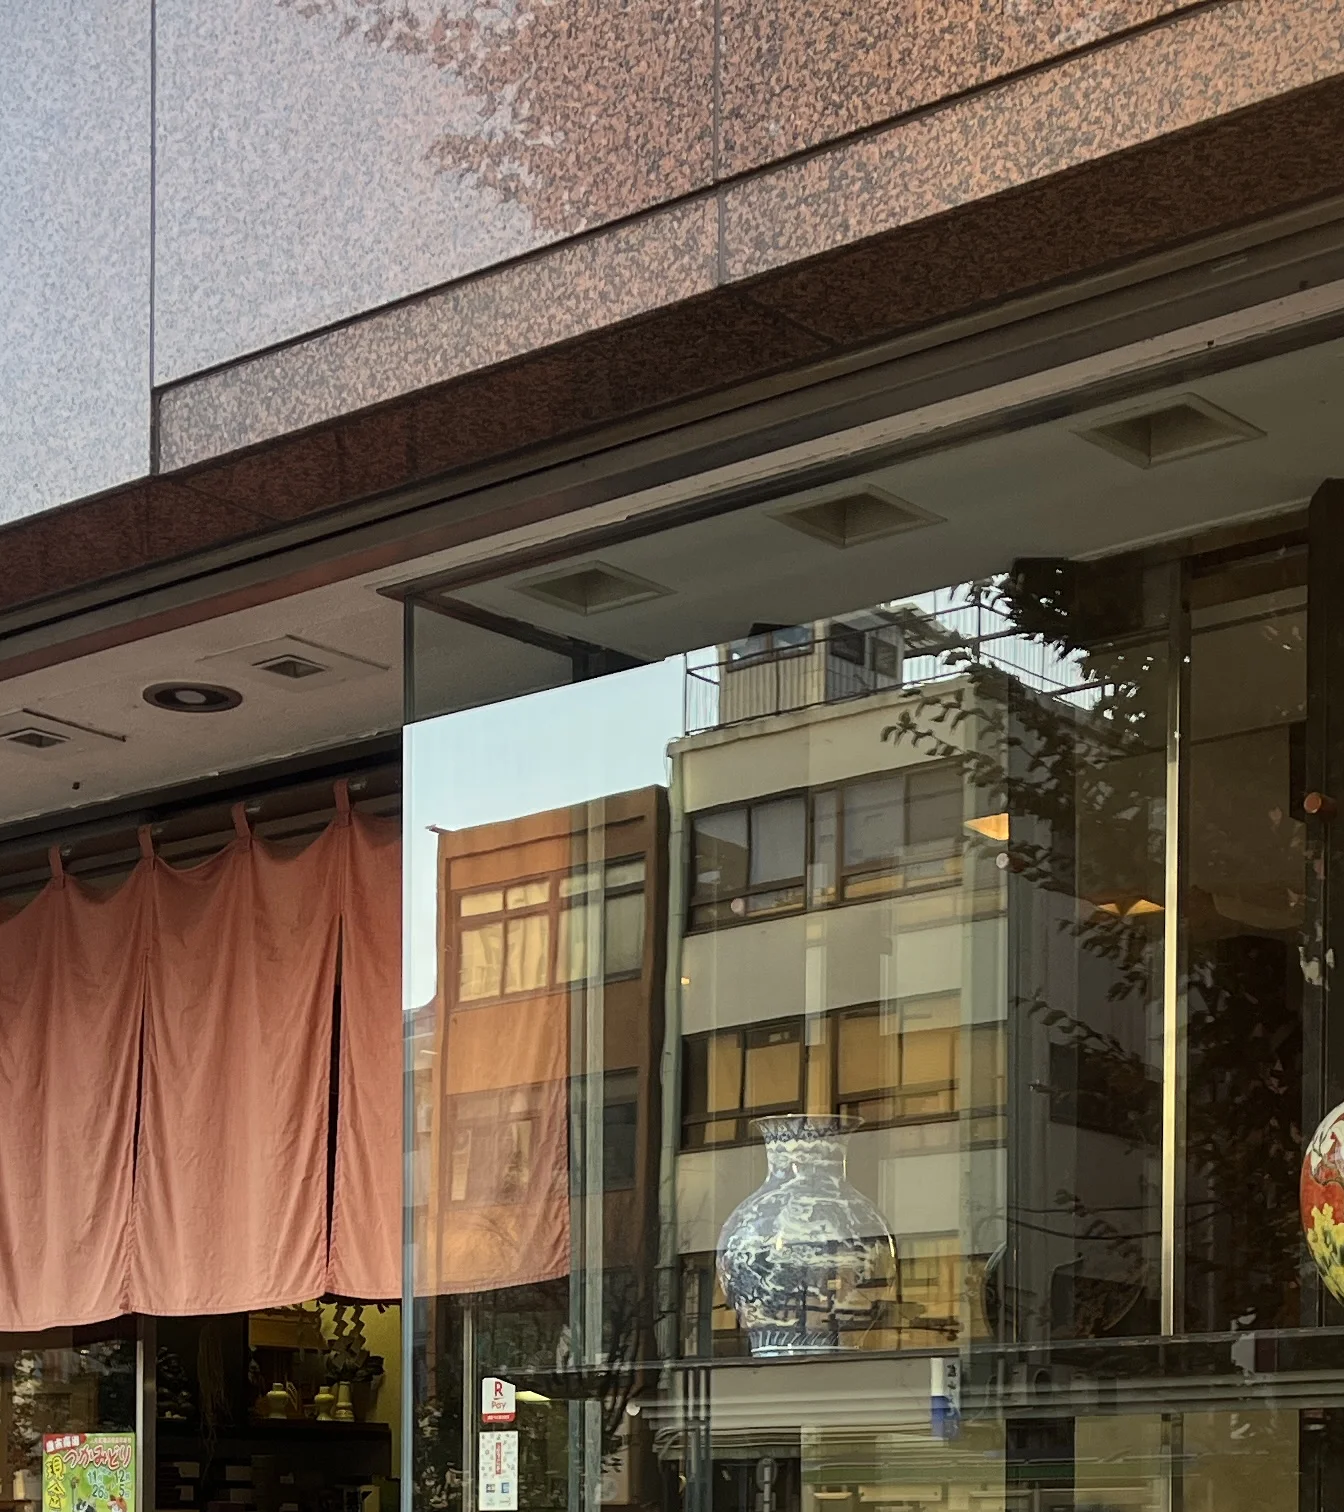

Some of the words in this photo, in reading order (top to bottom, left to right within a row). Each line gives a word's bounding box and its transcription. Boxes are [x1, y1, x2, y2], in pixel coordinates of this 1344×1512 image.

[491, 1401, 506, 1409] Pay
[63, 1444, 131, 1470] つかみどり
[45, 1455, 65, 1510] 現金
